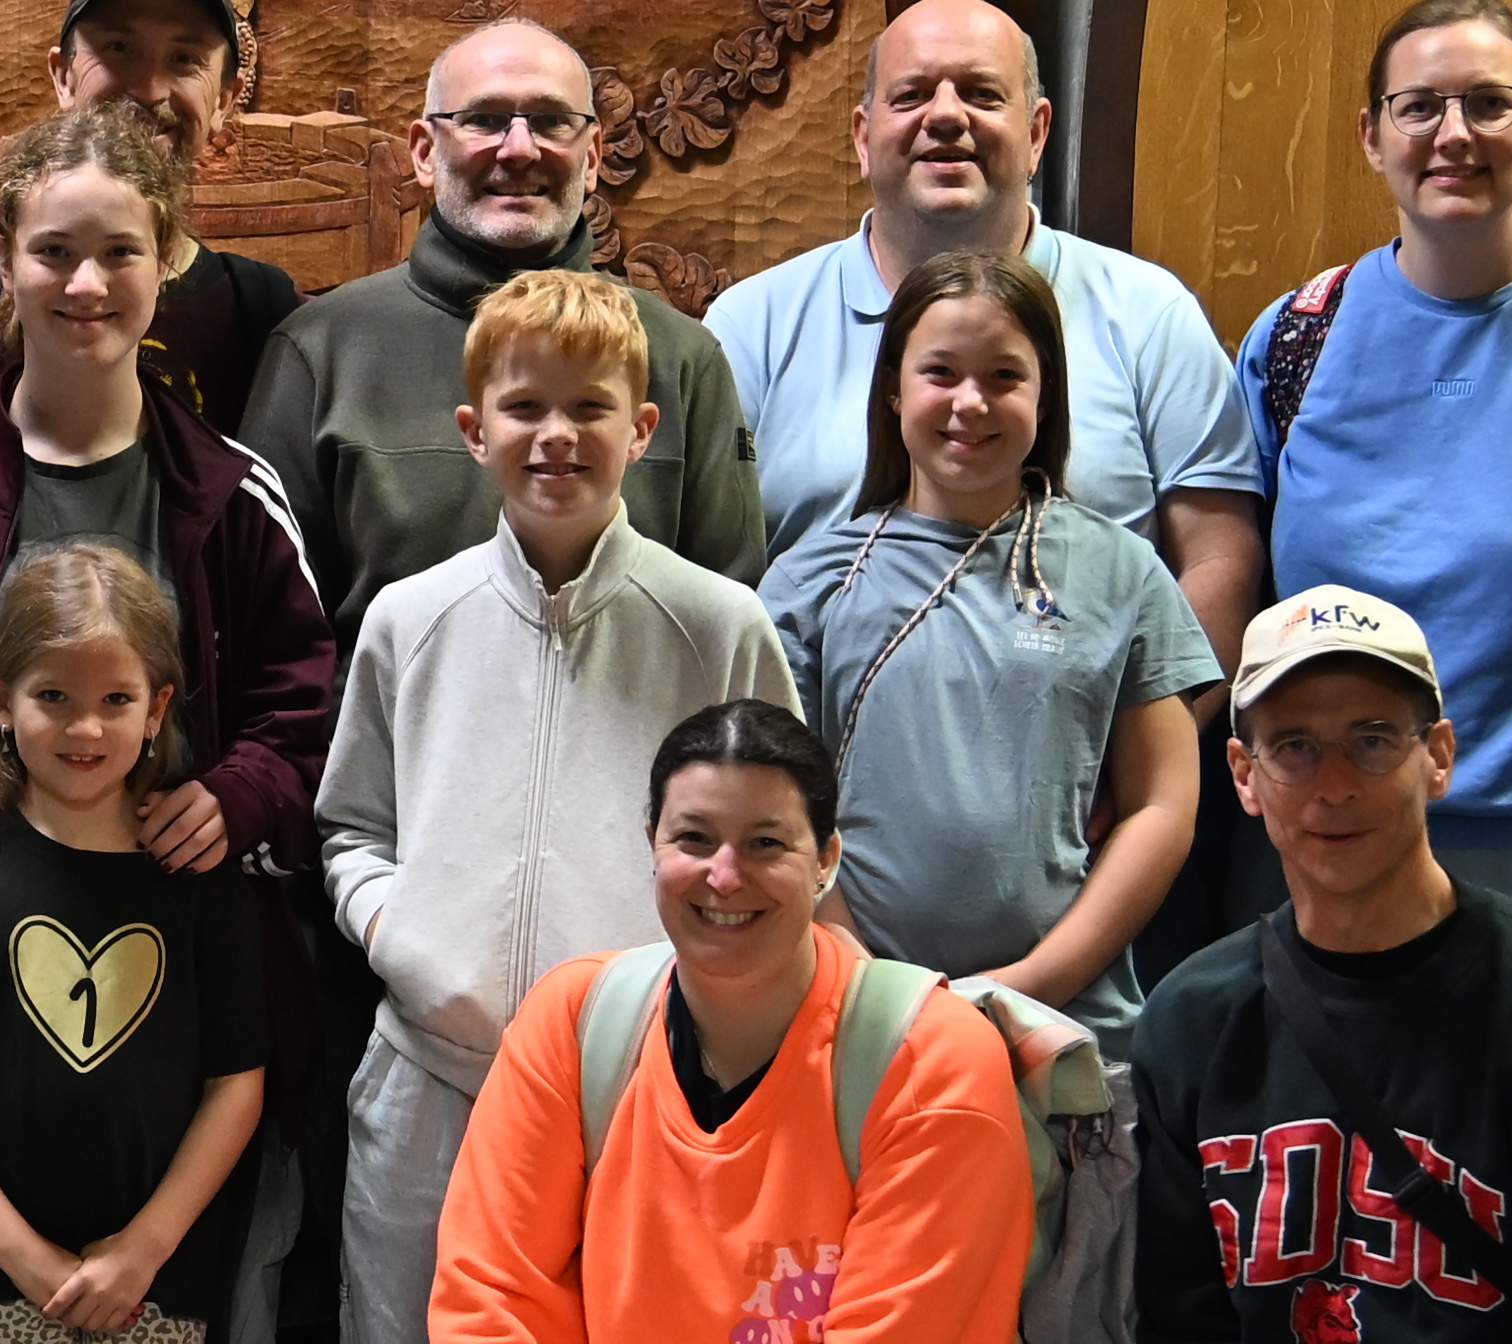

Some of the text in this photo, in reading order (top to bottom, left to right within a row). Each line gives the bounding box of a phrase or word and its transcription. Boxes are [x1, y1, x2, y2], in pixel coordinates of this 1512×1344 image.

[1431, 378, 1475, 397] PUMA
[68, 976, 98, 1049] 1
[741, 1279, 774, 1317] A
